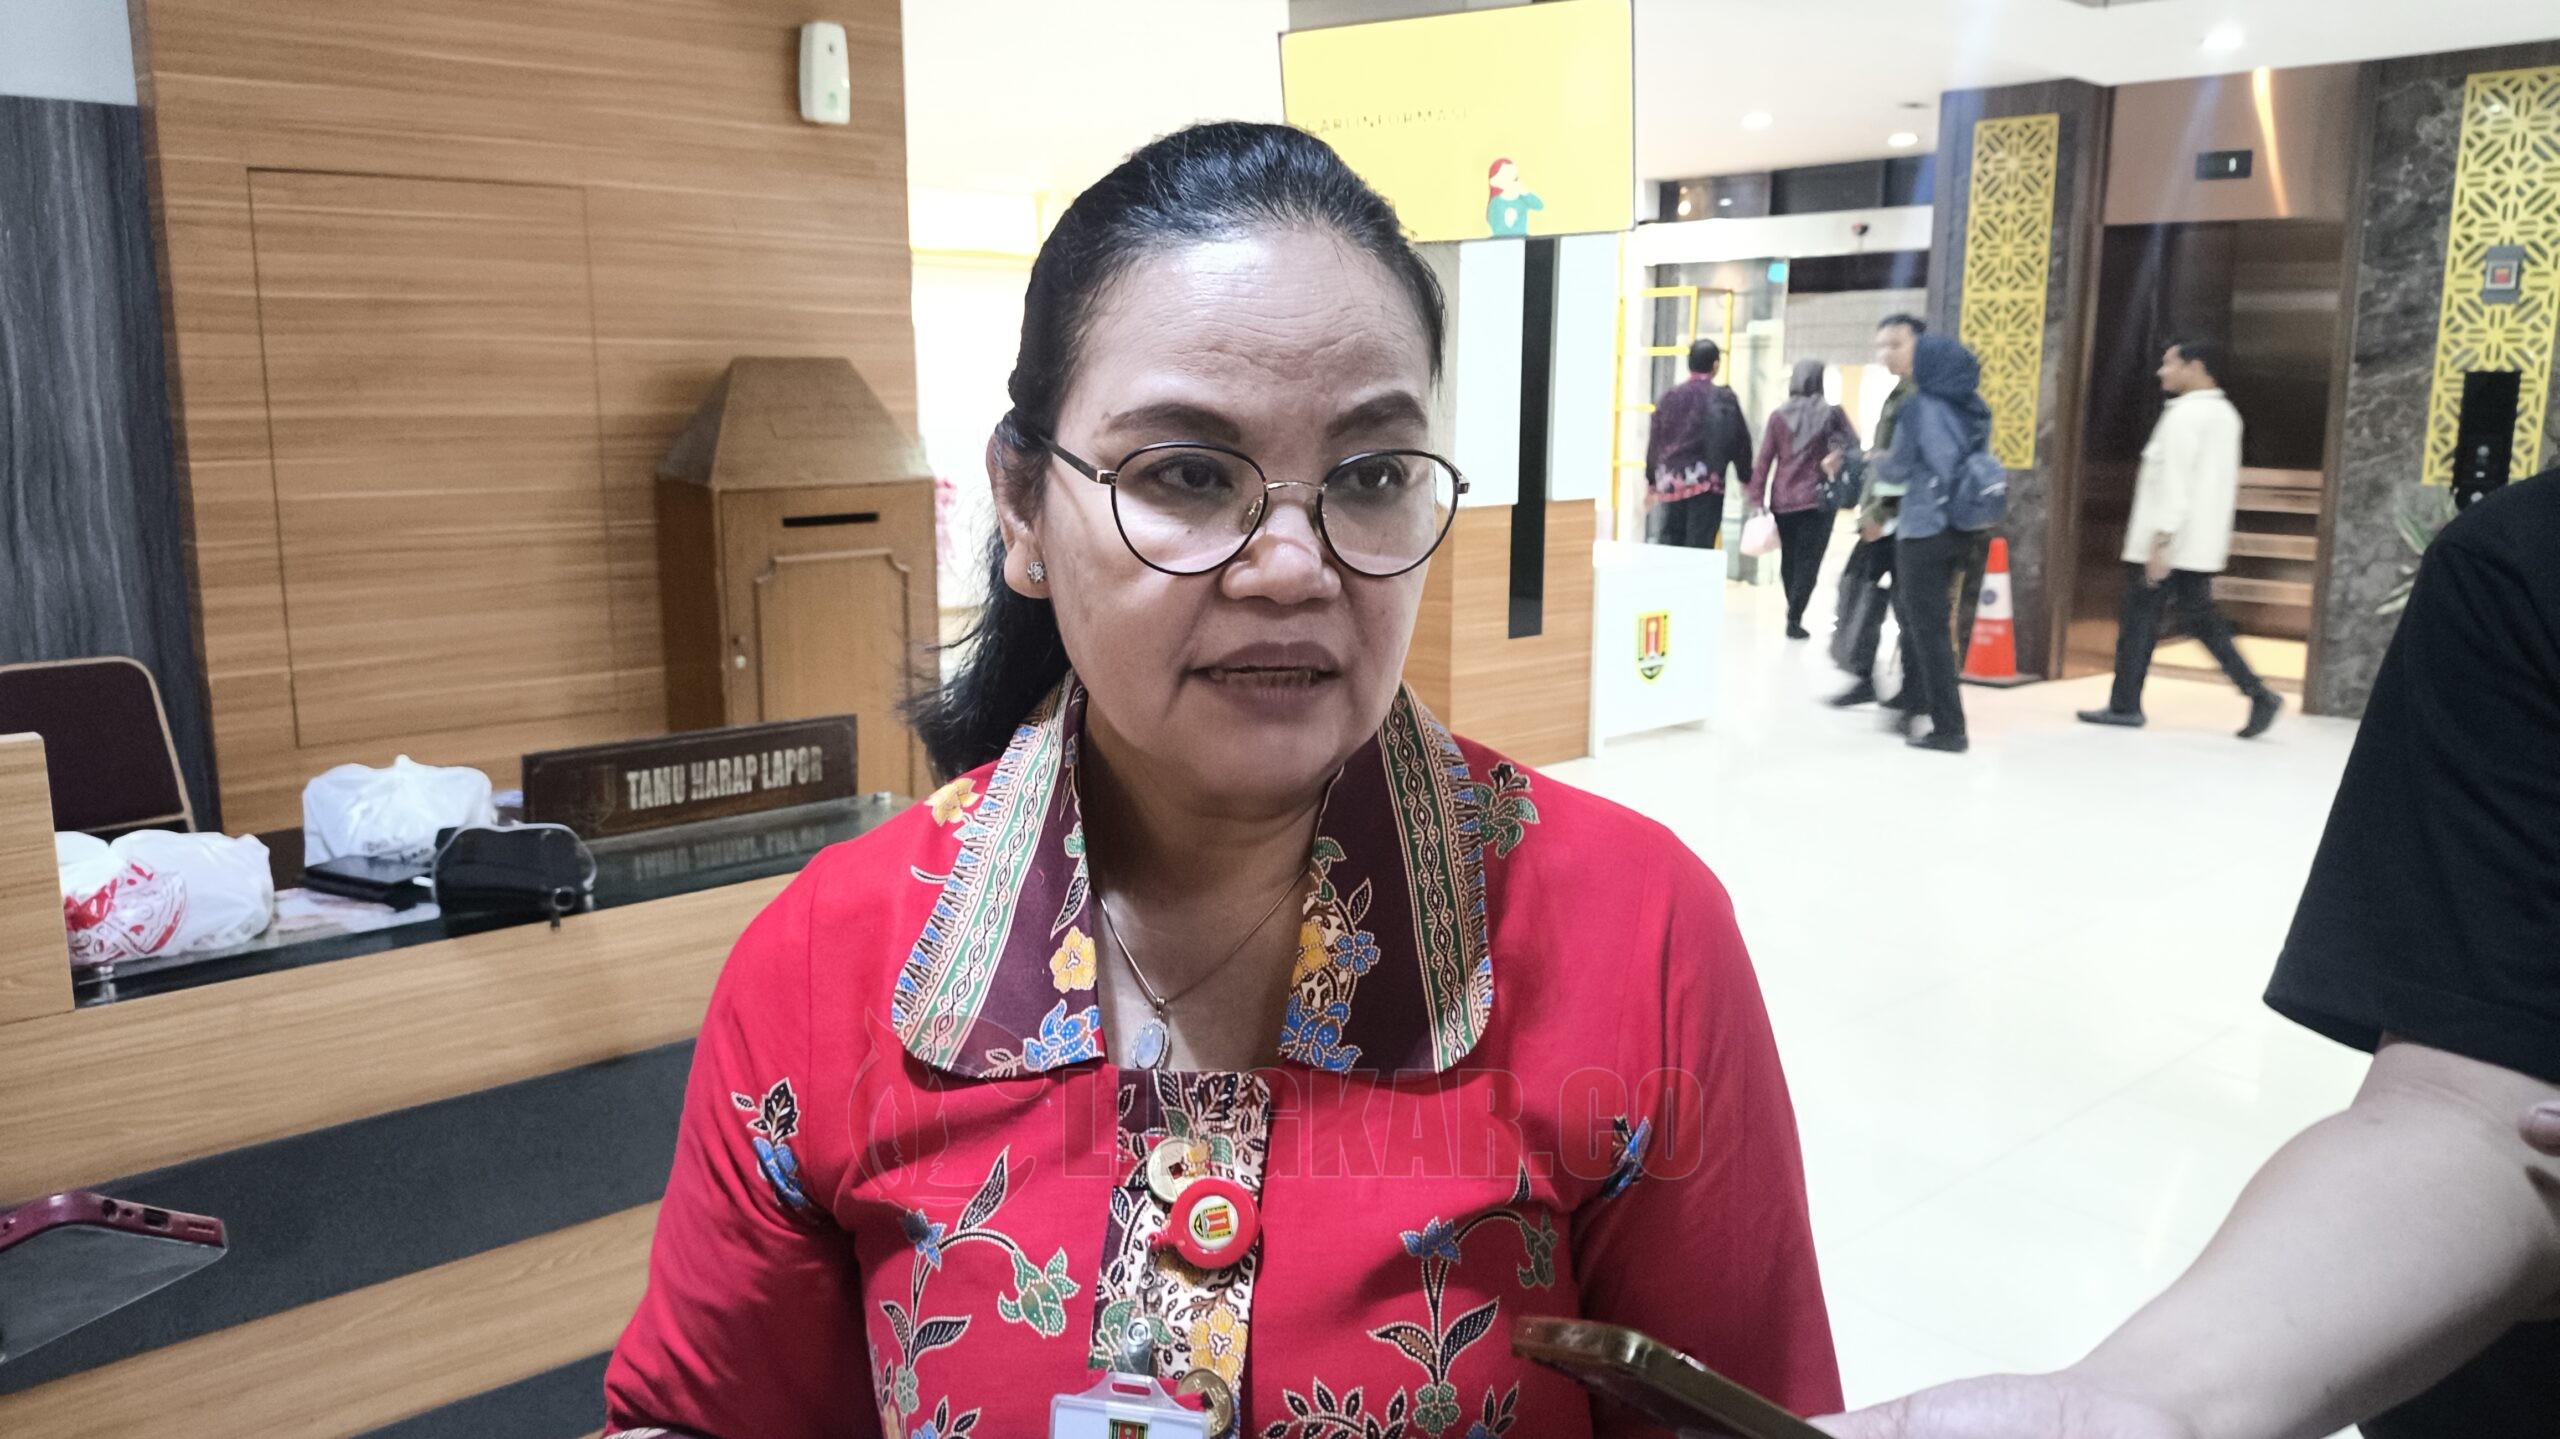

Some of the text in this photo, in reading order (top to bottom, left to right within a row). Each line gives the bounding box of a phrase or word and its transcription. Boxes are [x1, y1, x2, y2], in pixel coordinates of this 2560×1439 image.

[626, 745, 823, 810] TAMU HARAP LAPOR
